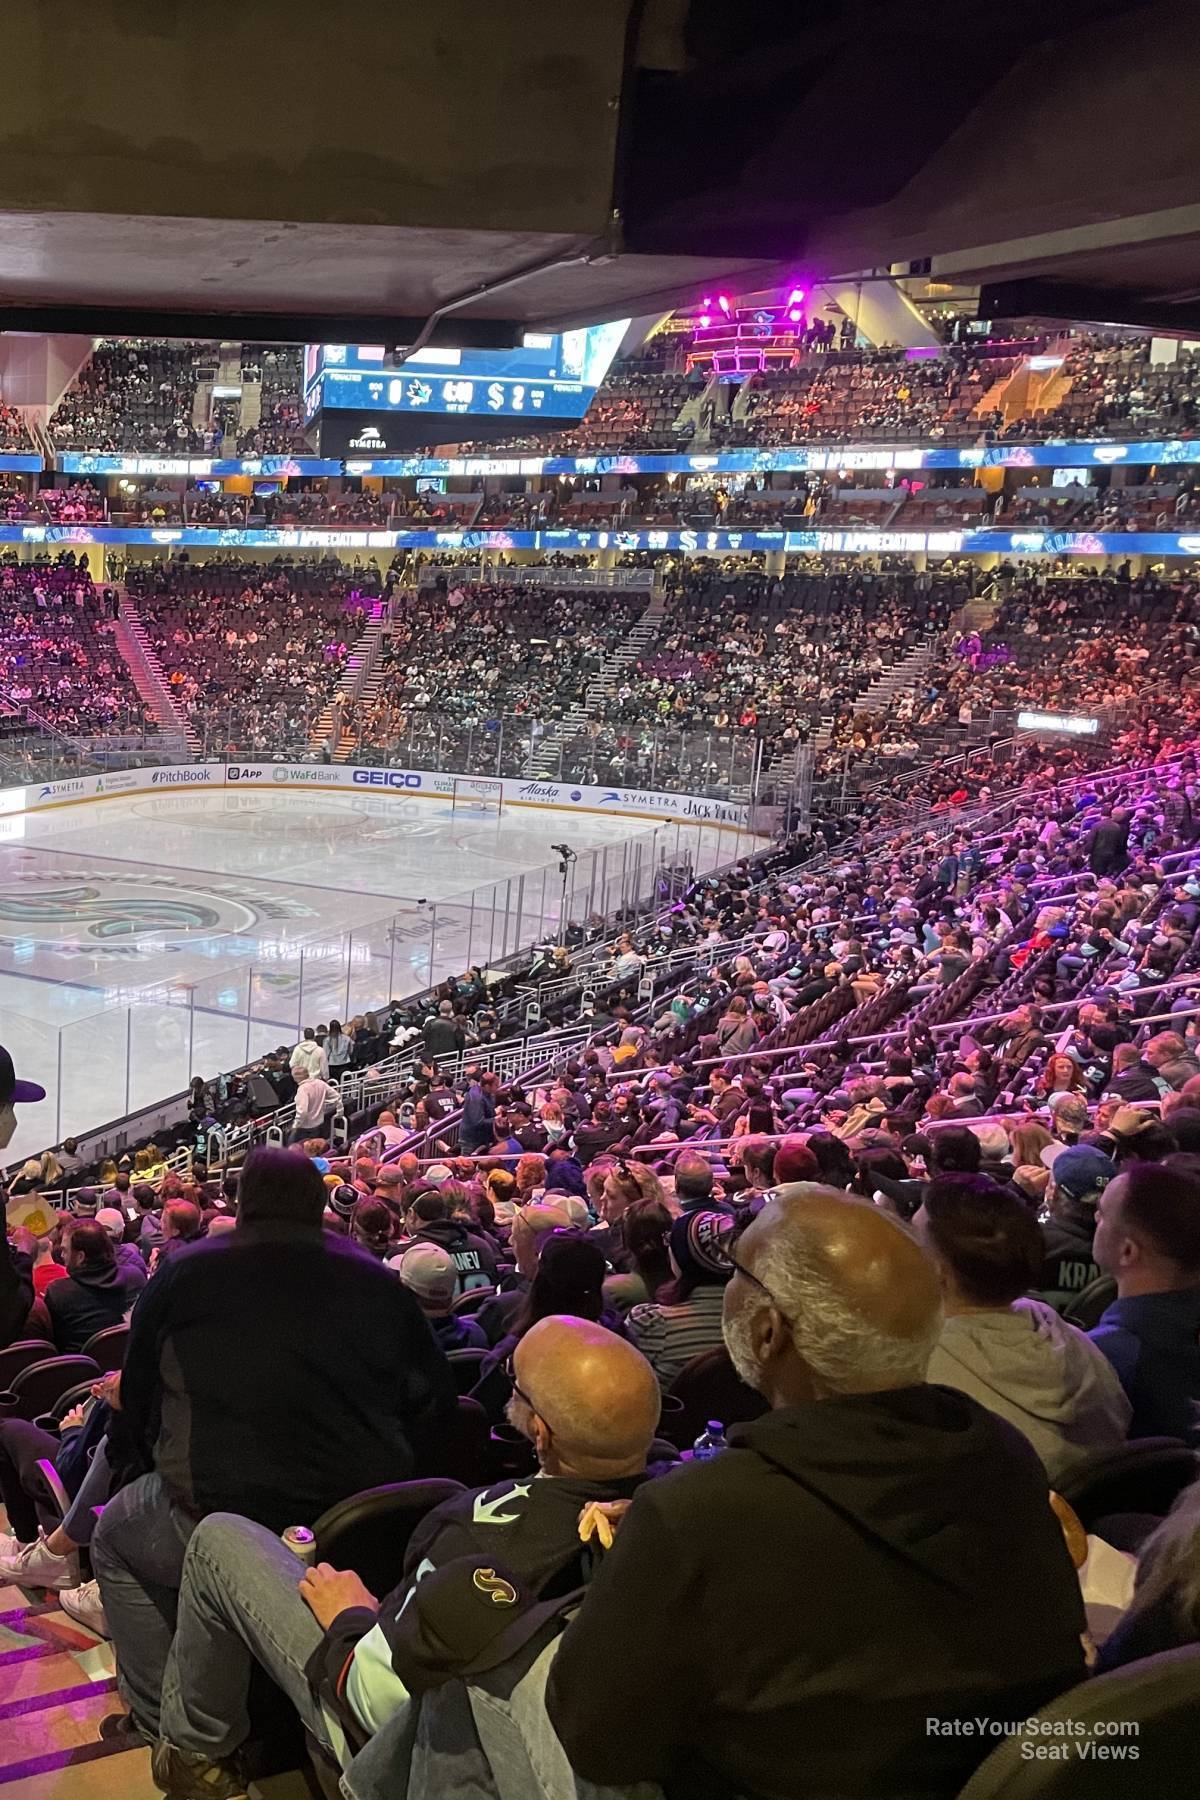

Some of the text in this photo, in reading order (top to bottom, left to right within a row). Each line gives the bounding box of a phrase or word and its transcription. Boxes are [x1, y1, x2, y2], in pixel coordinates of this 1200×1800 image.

[349, 439, 386, 449] SYMETRA
[160, 769, 211, 783] PitchBook
[352, 770, 422, 787] GEICO
[53, 782, 84, 794] SYMETRA
[519, 783, 560, 797] Alaska
[623, 793, 678, 808] SYMETRA
